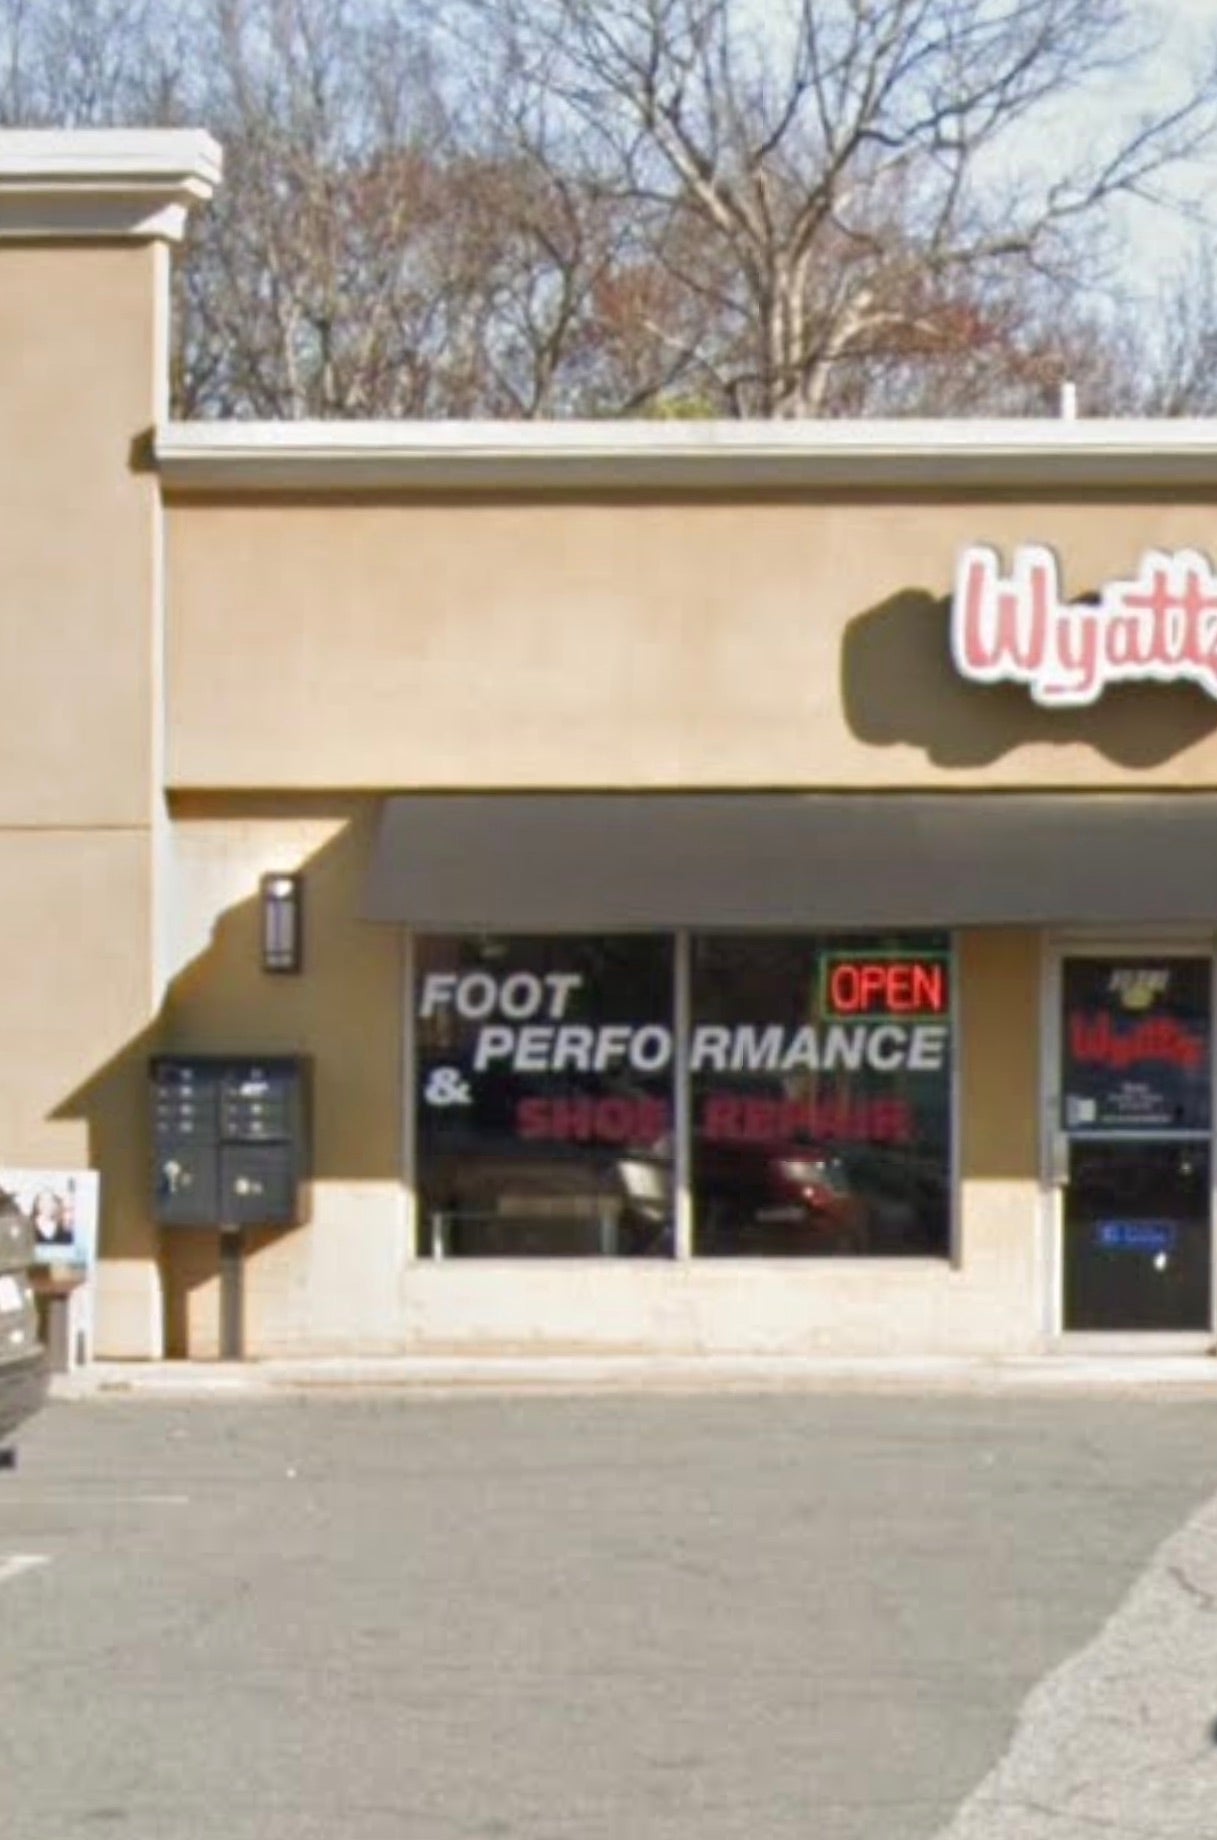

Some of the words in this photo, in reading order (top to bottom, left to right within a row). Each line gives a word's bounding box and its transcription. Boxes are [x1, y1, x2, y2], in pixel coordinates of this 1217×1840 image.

[419, 972, 582, 1018] FOOT
[831, 964, 943, 1011] OPEN
[424, 1066, 472, 1105] &
[514, 1097, 667, 1144] SHOE
